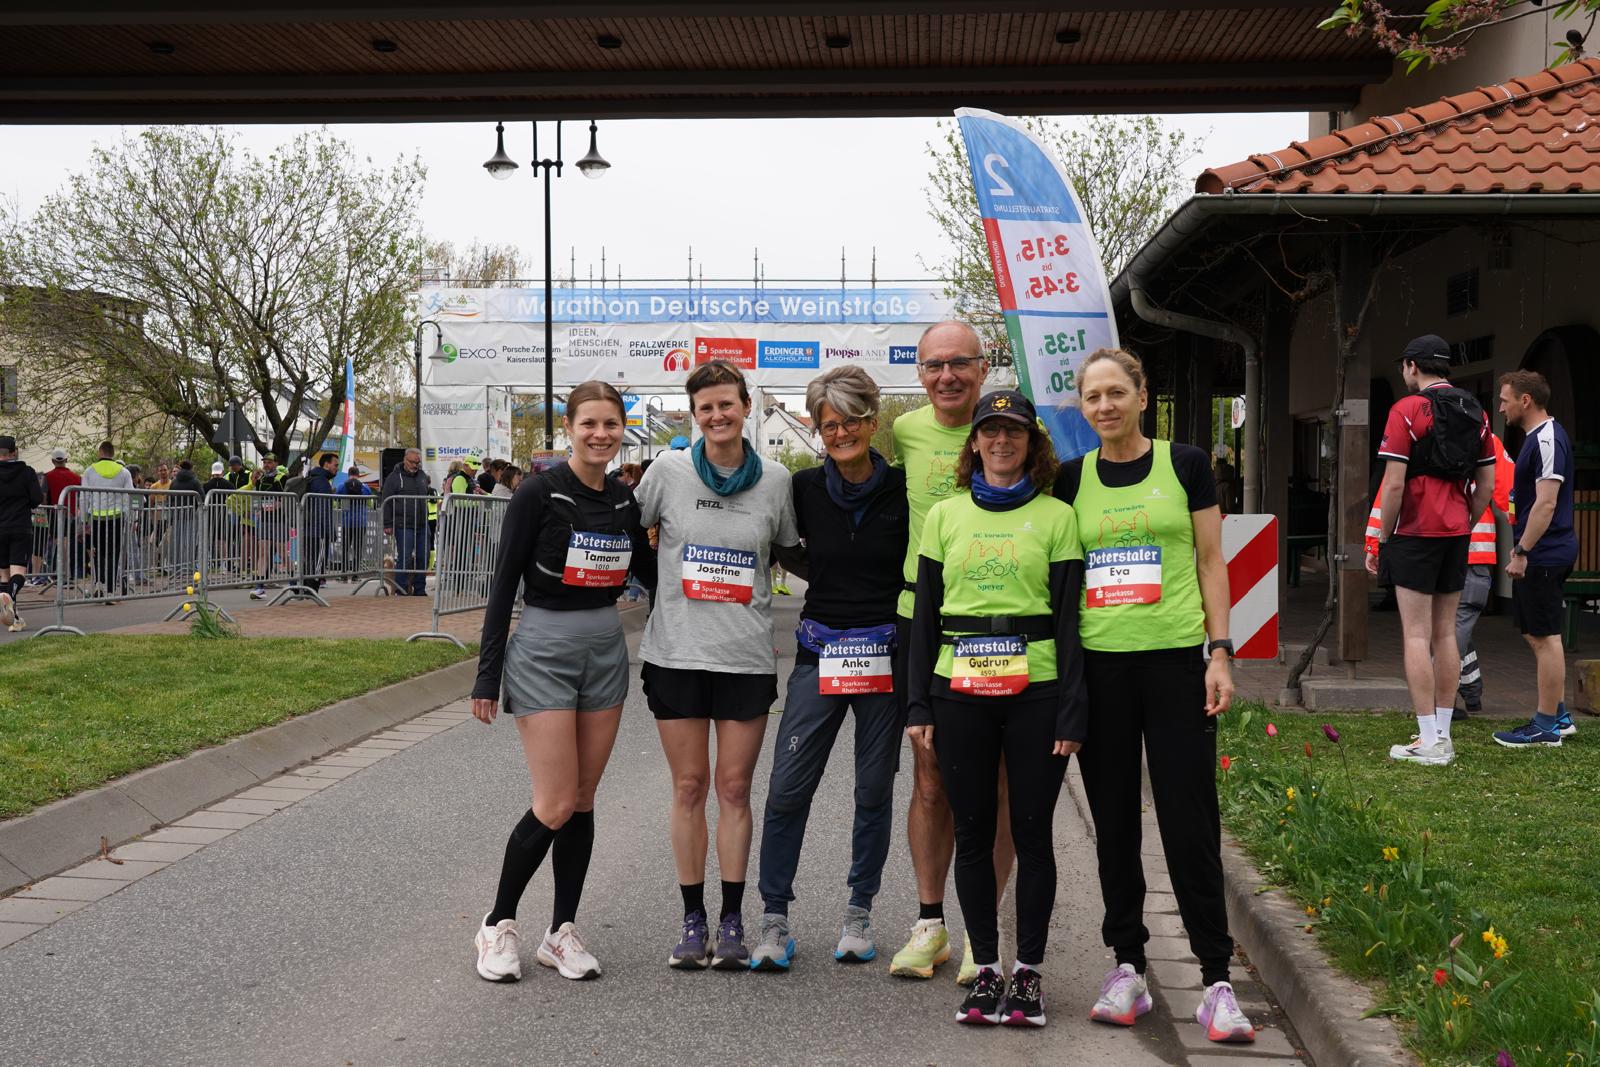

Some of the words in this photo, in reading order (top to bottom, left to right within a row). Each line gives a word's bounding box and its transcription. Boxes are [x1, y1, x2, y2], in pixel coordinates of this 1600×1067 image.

[516, 296, 640, 317] Marathon
[650, 296, 770, 317] Deutsche
[779, 296, 921, 317] Weinstraße
[568, 328, 599, 339] IDEEN,
[502, 345, 530, 354] Porsche
[531, 345, 562, 354] Zenum
[568, 339, 623, 349] MENSCHEN,
[629, 340, 689, 349] PFALZWERKE
[459, 348, 497, 360] EXCO
[568, 348, 618, 358] LÖSUNGEN
[629, 349, 665, 358] GRUPPE
[709, 347, 743, 358] Sparkasse
[764, 346, 805, 356] ERDINGER
[506, 355, 557, 364] Kaiserslautn
[438, 446, 471, 456] Stiegler
[696, 499, 724, 510] PETZL
[572, 533, 631, 549] Peterstaler
[584, 550, 620, 562] Tamara
[686, 545, 754, 565] Peterstaler
[1088, 549, 1158, 569] Peterstaler
[696, 563, 741, 577] Josefine
[1109, 567, 1130, 576] Eva
[711, 575, 725, 583] 525
[702, 585, 730, 594] Sparkasse
[976, 583, 1005, 592] Speyer
[1104, 590, 1135, 598] Sparkasse
[822, 643, 889, 658] Peterstaler
[956, 640, 1023, 657] Peterstaler
[841, 657, 871, 668] Anke
[968, 657, 1009, 668] Gudrun
